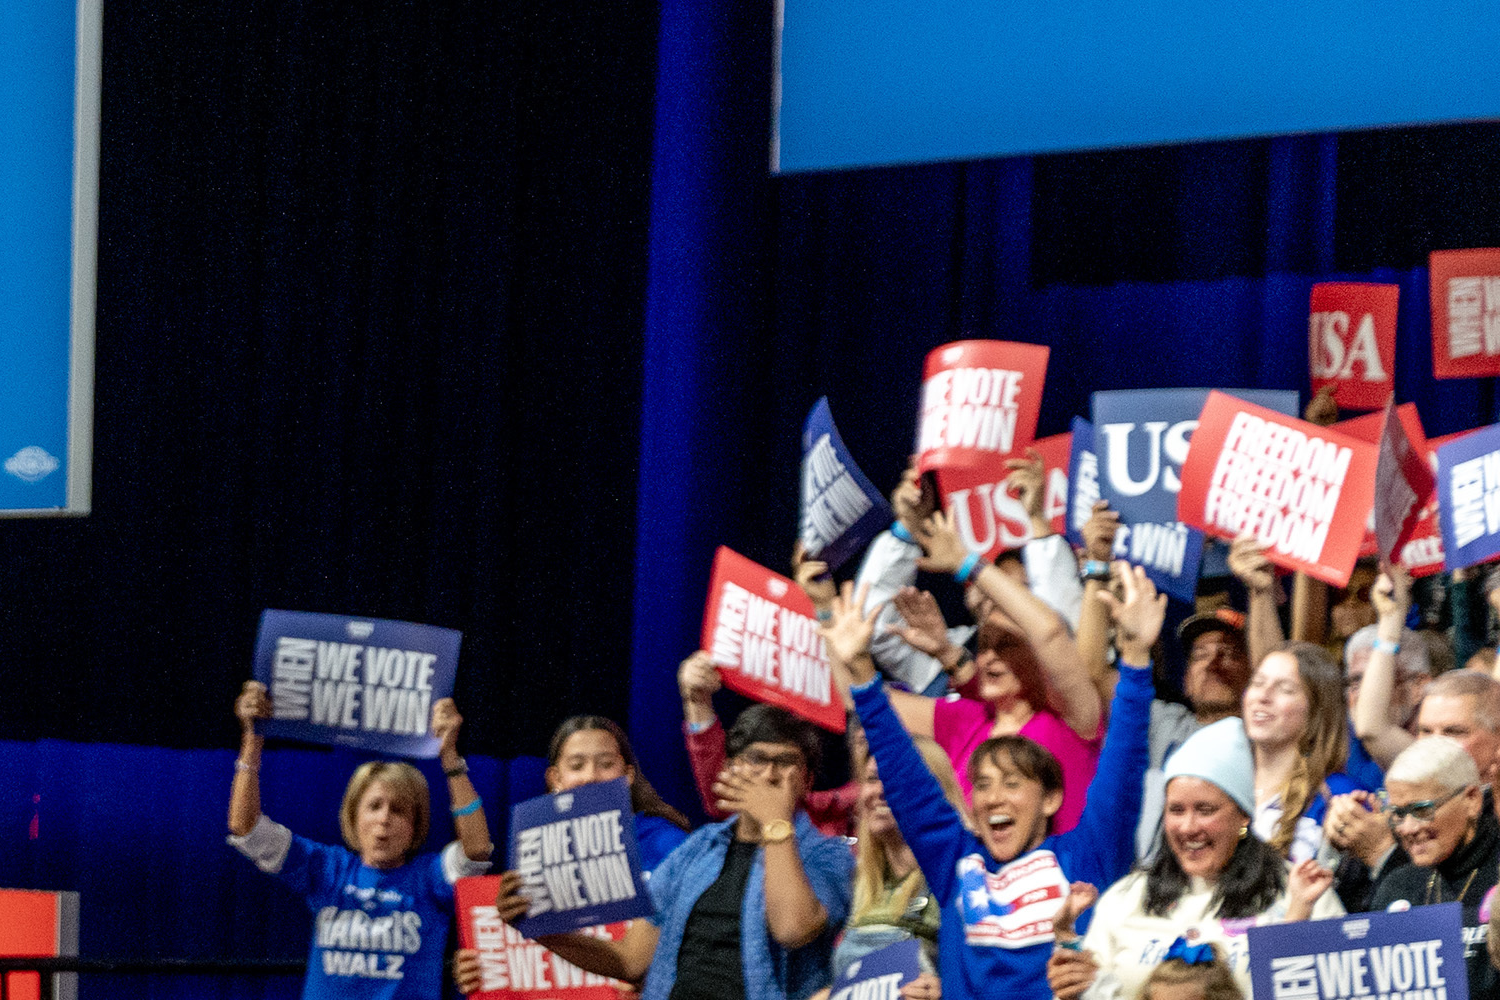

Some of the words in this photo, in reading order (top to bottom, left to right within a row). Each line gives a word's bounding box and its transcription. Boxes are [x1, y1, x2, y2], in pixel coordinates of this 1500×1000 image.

[949, 367, 1024, 409] VOTE
[946, 405, 1019, 455] WIN
[1102, 420, 1200, 497] US
[1222, 411, 1353, 486] FREEDOM
[1211, 448, 1342, 524] FREEDOM
[1204, 484, 1331, 564] FREEDOM
[745, 592, 781, 642] WE
[272, 636, 318, 719] WHEN
[316, 641, 364, 684] WE
[365, 646, 437, 691] VOTE
[740, 630, 780, 686] WE
[779, 646, 832, 706] WIN
[311, 679, 362, 728] WE
[363, 684, 431, 736] WIN
[541, 820, 575, 866] WE
[571, 809, 626, 860] VOTE
[543, 861, 589, 912] WE
[580, 852, 637, 905] WIN
[322, 950, 405, 980] WALZ
[471, 905, 510, 992] WHEN
[505, 944, 552, 992] WE
[1316, 949, 1370, 1000] WE
[1369, 939, 1446, 994] VOTE
